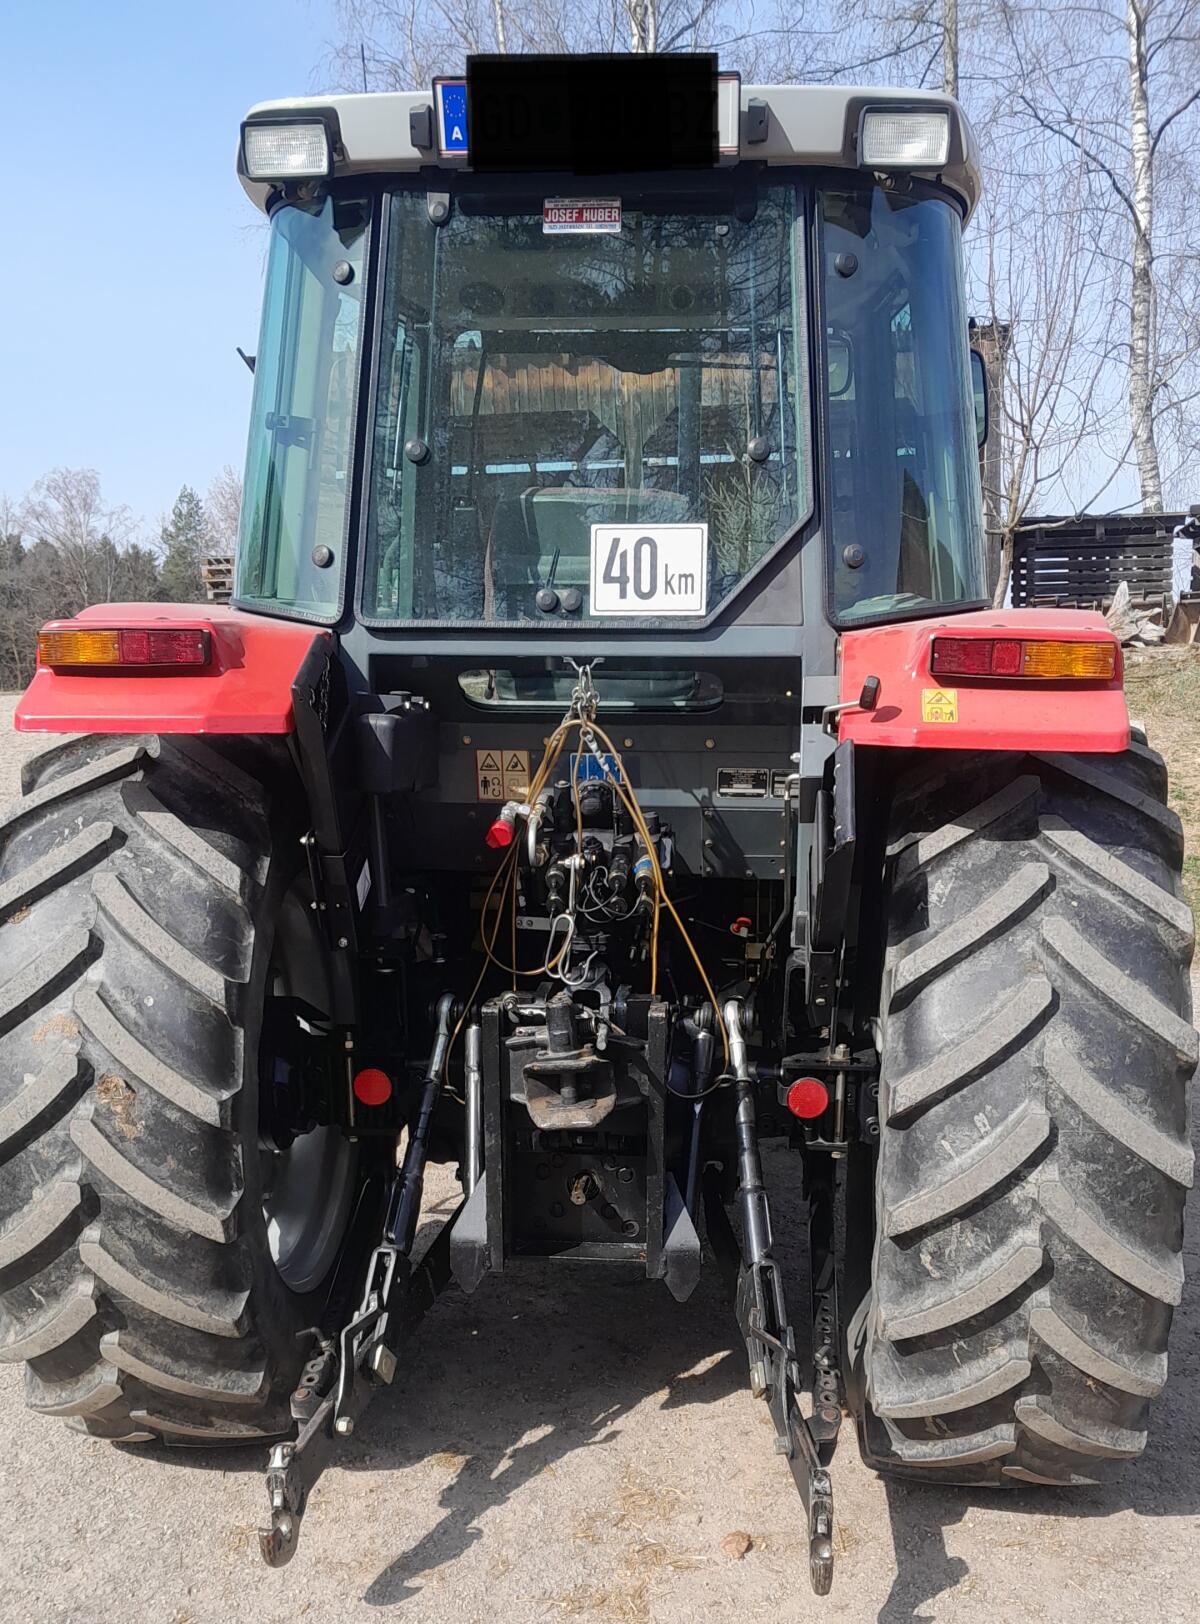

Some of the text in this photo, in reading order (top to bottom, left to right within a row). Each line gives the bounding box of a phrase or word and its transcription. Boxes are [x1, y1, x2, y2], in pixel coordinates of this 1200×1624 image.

[452, 126, 463, 141] A
[544, 208, 619, 222] JOSEF HUBER
[602, 536, 695, 600] 40 km
